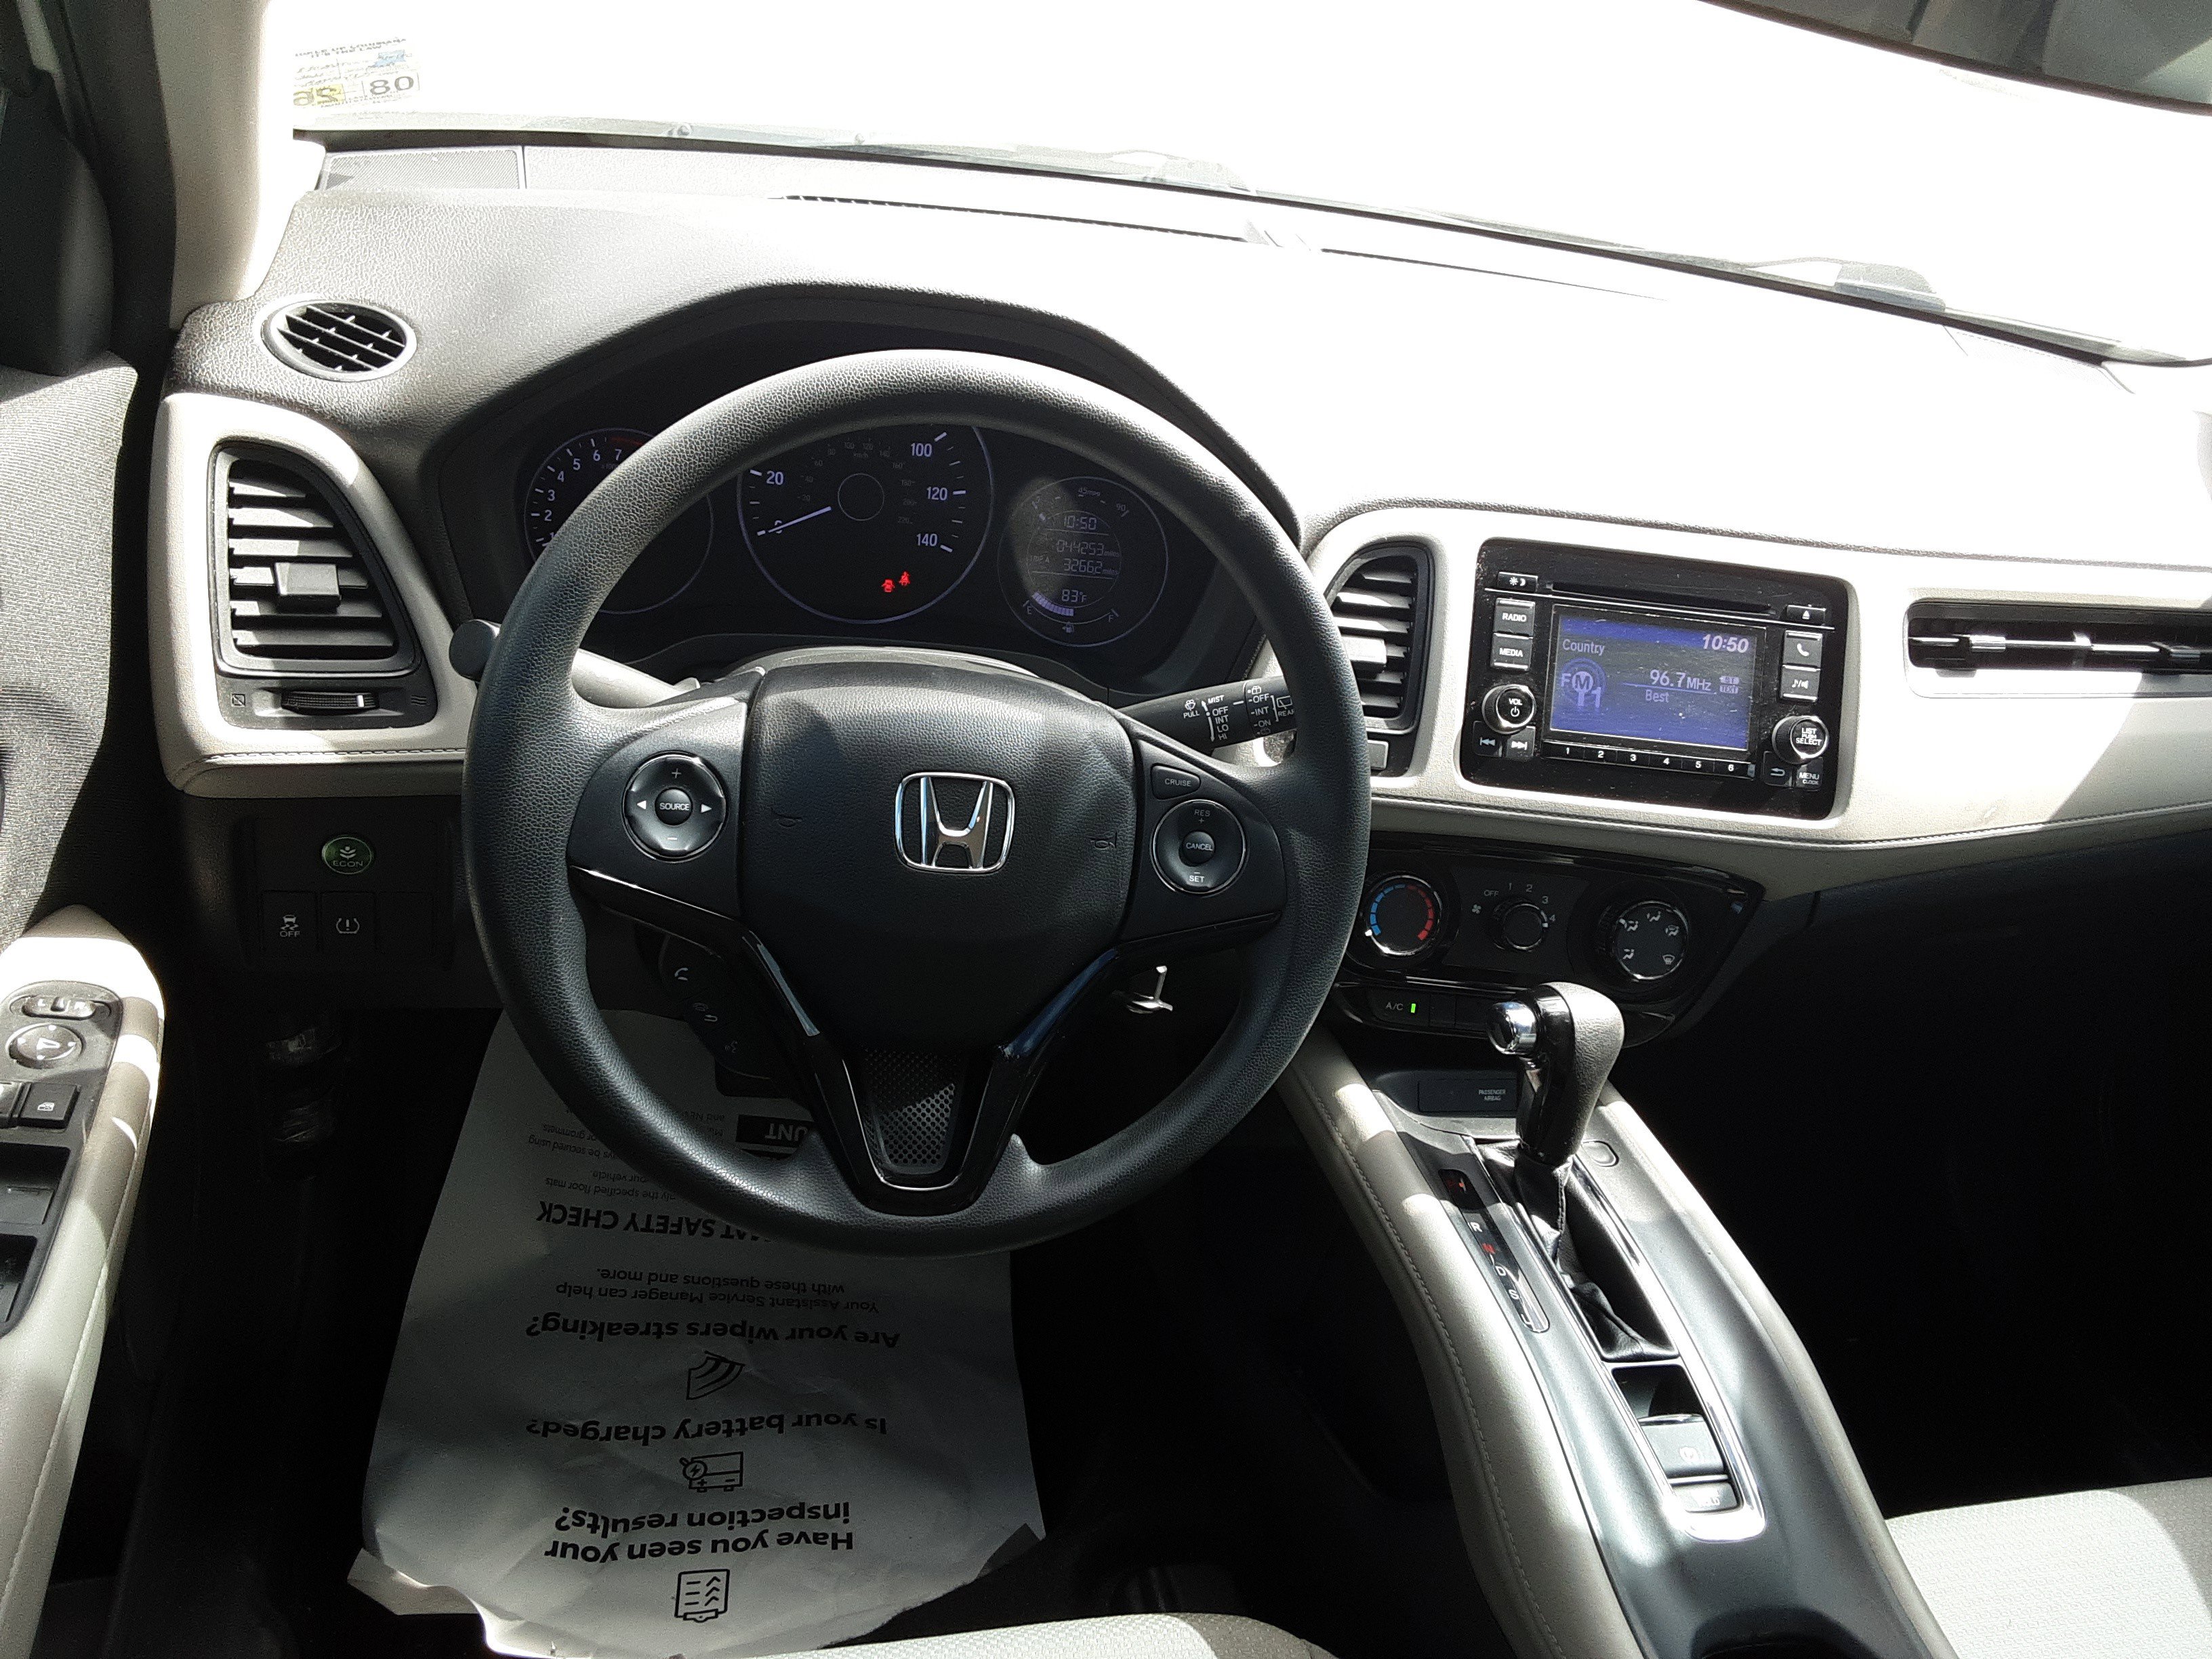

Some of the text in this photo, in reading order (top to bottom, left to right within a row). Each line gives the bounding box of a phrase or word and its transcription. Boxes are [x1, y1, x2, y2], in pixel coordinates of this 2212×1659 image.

[593, 449, 600, 462] 6
[615, 449, 622, 461] 7
[911, 443, 932, 457] 100
[573, 458, 581, 470] 5
[557, 471, 565, 483] 4
[766, 471, 784, 485] 20
[547, 489, 555, 501] 3
[927, 487, 947, 501] 120
[1116, 503, 1126, 512] 90
[544, 510, 552, 521] 2
[1064, 516, 1097, 531] 10:50
[916, 533, 938, 548] 140
[1056, 539, 1103, 556] 044253
[1063, 558, 1103, 575] 32662
[1027, 607, 1031, 615] E
[1109, 614, 1113, 622] F
[1502, 612, 1527, 623] RADIO
[1562, 638, 1605, 656] Country
[1702, 634, 1749, 653] 10:50
[1499, 647, 1523, 657] MEDIA
[1650, 669, 1712, 691] 96.7 MHz
[1208, 695, 1225, 704] MIST
[1253, 693, 1270, 703] OFF
[1645, 689, 1669, 703] Best
[1508, 697, 1523, 707] VOL
[1212, 706, 1229, 716] OFF
[1255, 707, 1269, 716] INT
[1215, 715, 1229, 724] INT
[1218, 724, 1229, 733] LO
[1566, 747, 1570, 755] 1
[1597, 750, 1604, 758] 2
[1630, 754, 1637, 762] 3
[1663, 757, 1670, 765] 4
[1695, 761, 1702, 769] 5
[1727, 763, 1734, 772] 6
[1799, 772, 1819, 780] MENU
[1165, 779, 1191, 787] CRUISE
[1525, 884, 1533, 893] 2
[1542, 896, 1549, 904] 3
[1385, 1002, 1404, 1010] A/C
[529, 1135, 551, 1147] using
[551, 1142, 586, 1155] secured
[588, 1149, 600, 1158] be
[545, 1177, 566, 1188] mats
[568, 1183, 591, 1194] floor
[594, 1185, 640, 1197] specified
[642, 1191, 659, 1200] the
[535, 1202, 619, 1229] CHECK
[623, 1212, 716, 1235] SAFETY
[1472, 1222, 1483, 1232] R
[1496, 1266, 1507, 1276] D
[596, 1268, 845, 1296] with these questions and more.
[556, 1282, 880, 1314] Your Assistant Service Manager can help
[1509, 1289, 1519, 1300] S
[525, 1312, 901, 1349] Are your wipers streaking?
[525, 1412, 888, 1447] Is your battery charged?
[554, 1501, 850, 1538] inspection results?
[544, 1531, 854, 1564] Have you seen your
